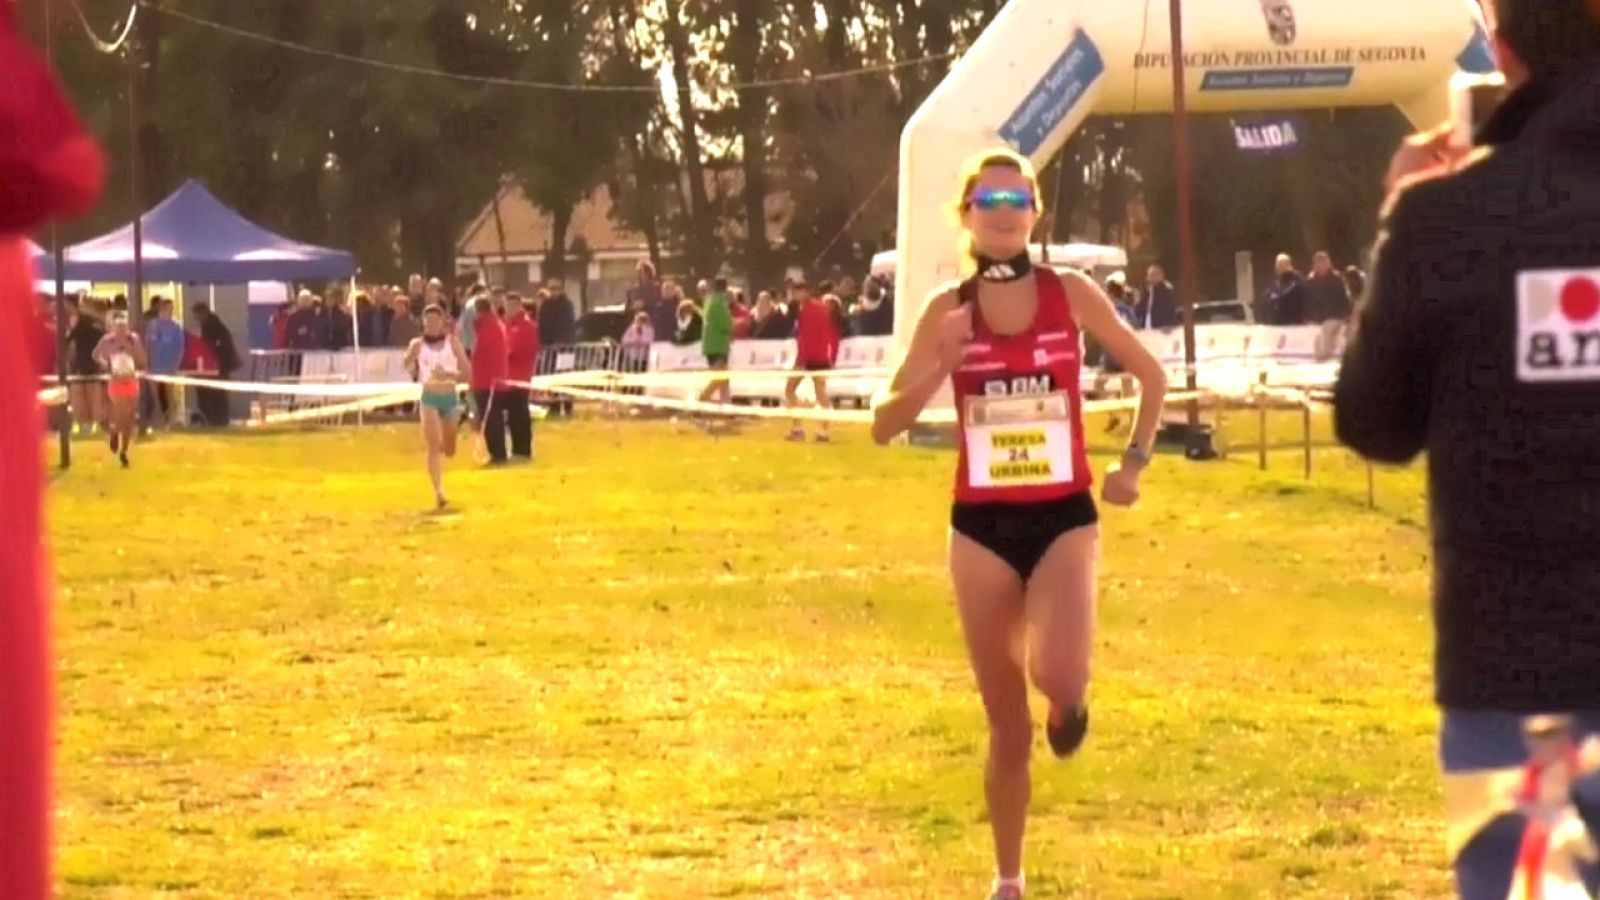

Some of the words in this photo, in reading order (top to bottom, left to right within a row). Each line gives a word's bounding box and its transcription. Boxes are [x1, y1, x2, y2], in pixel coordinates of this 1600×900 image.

[1133, 49, 1230, 68] DIPUACIÓN
[1234, 49, 1327, 66] PROVINCIAL
[1333, 48, 1352, 63] DE
[1357, 45, 1426, 61] SEGOVIA
[1234, 121, 1297, 149] SALIDA
[991, 433, 1047, 448] TERESA
[989, 462, 1053, 479] URBINA
